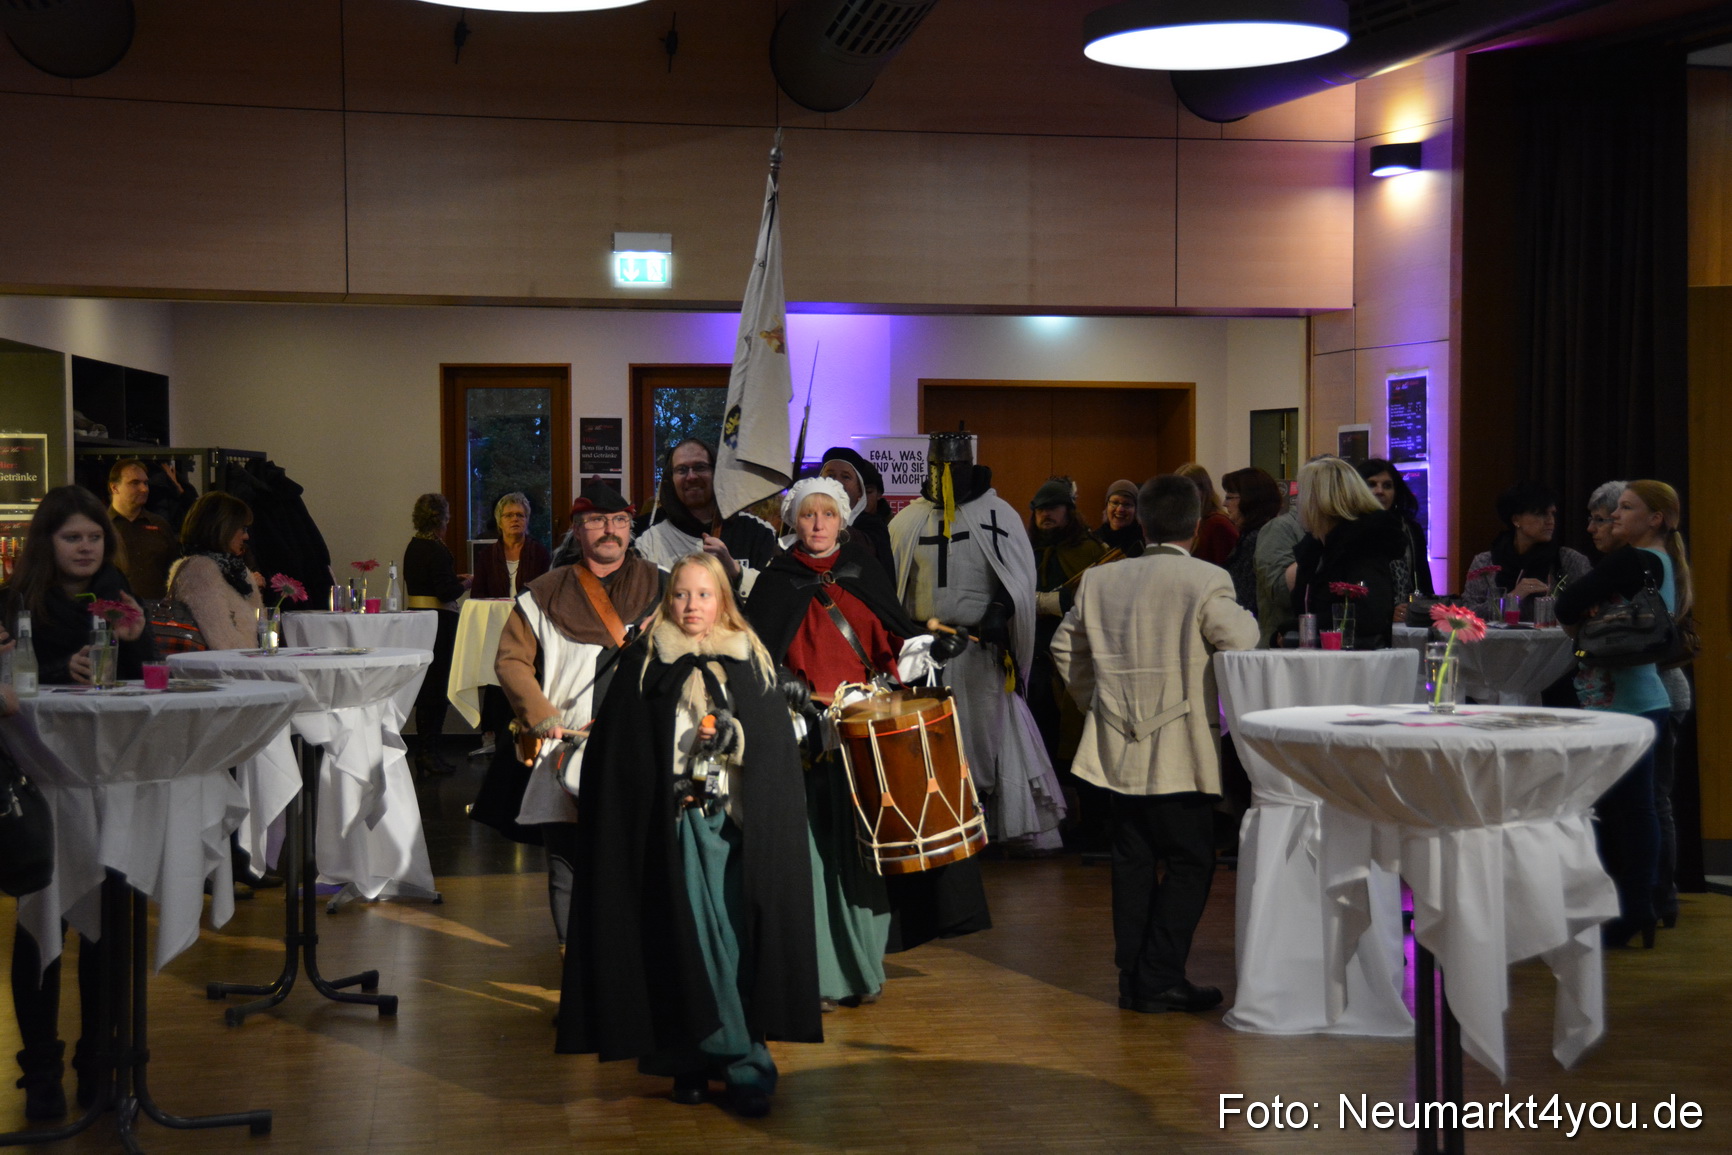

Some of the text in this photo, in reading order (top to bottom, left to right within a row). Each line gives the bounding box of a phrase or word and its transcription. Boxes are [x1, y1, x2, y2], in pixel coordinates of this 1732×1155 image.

[870, 450, 925, 462] EGAL, WAS,
[891, 462, 908, 473] WO
[911, 462, 925, 473] SIE
